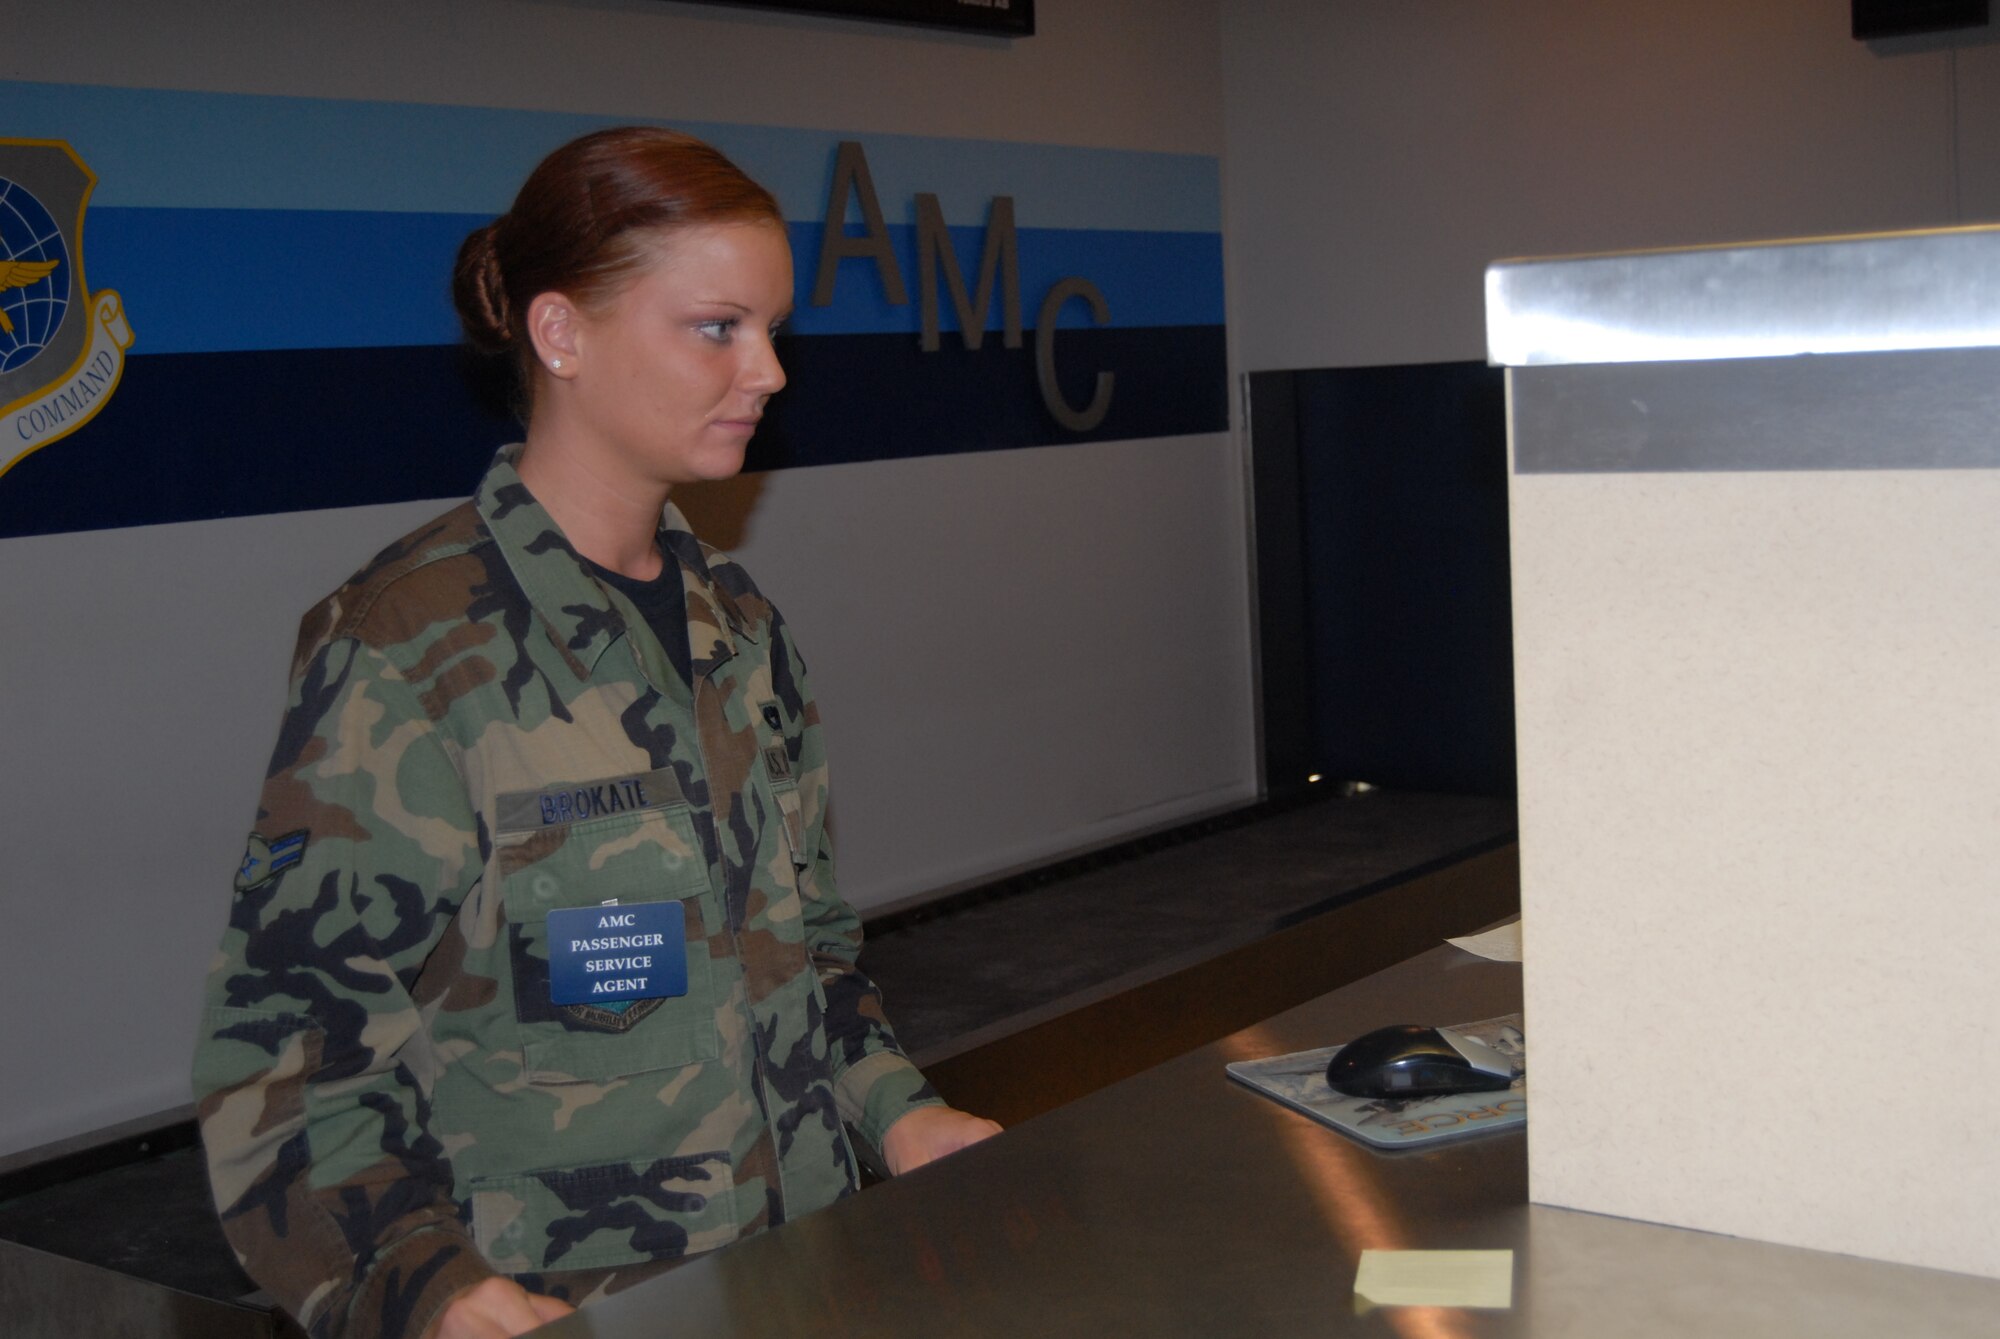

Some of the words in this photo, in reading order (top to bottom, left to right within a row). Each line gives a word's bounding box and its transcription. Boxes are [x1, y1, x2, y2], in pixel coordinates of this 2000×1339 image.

[810, 141, 1115, 431] AMC
[17, 350, 114, 440] COMMAND
[540, 779, 651, 825] BROKATE
[598, 914, 636, 929] AMC
[571, 933, 664, 952] PASSENGER
[586, 956, 652, 973] SERVICE
[592, 978, 648, 994] AGENT
